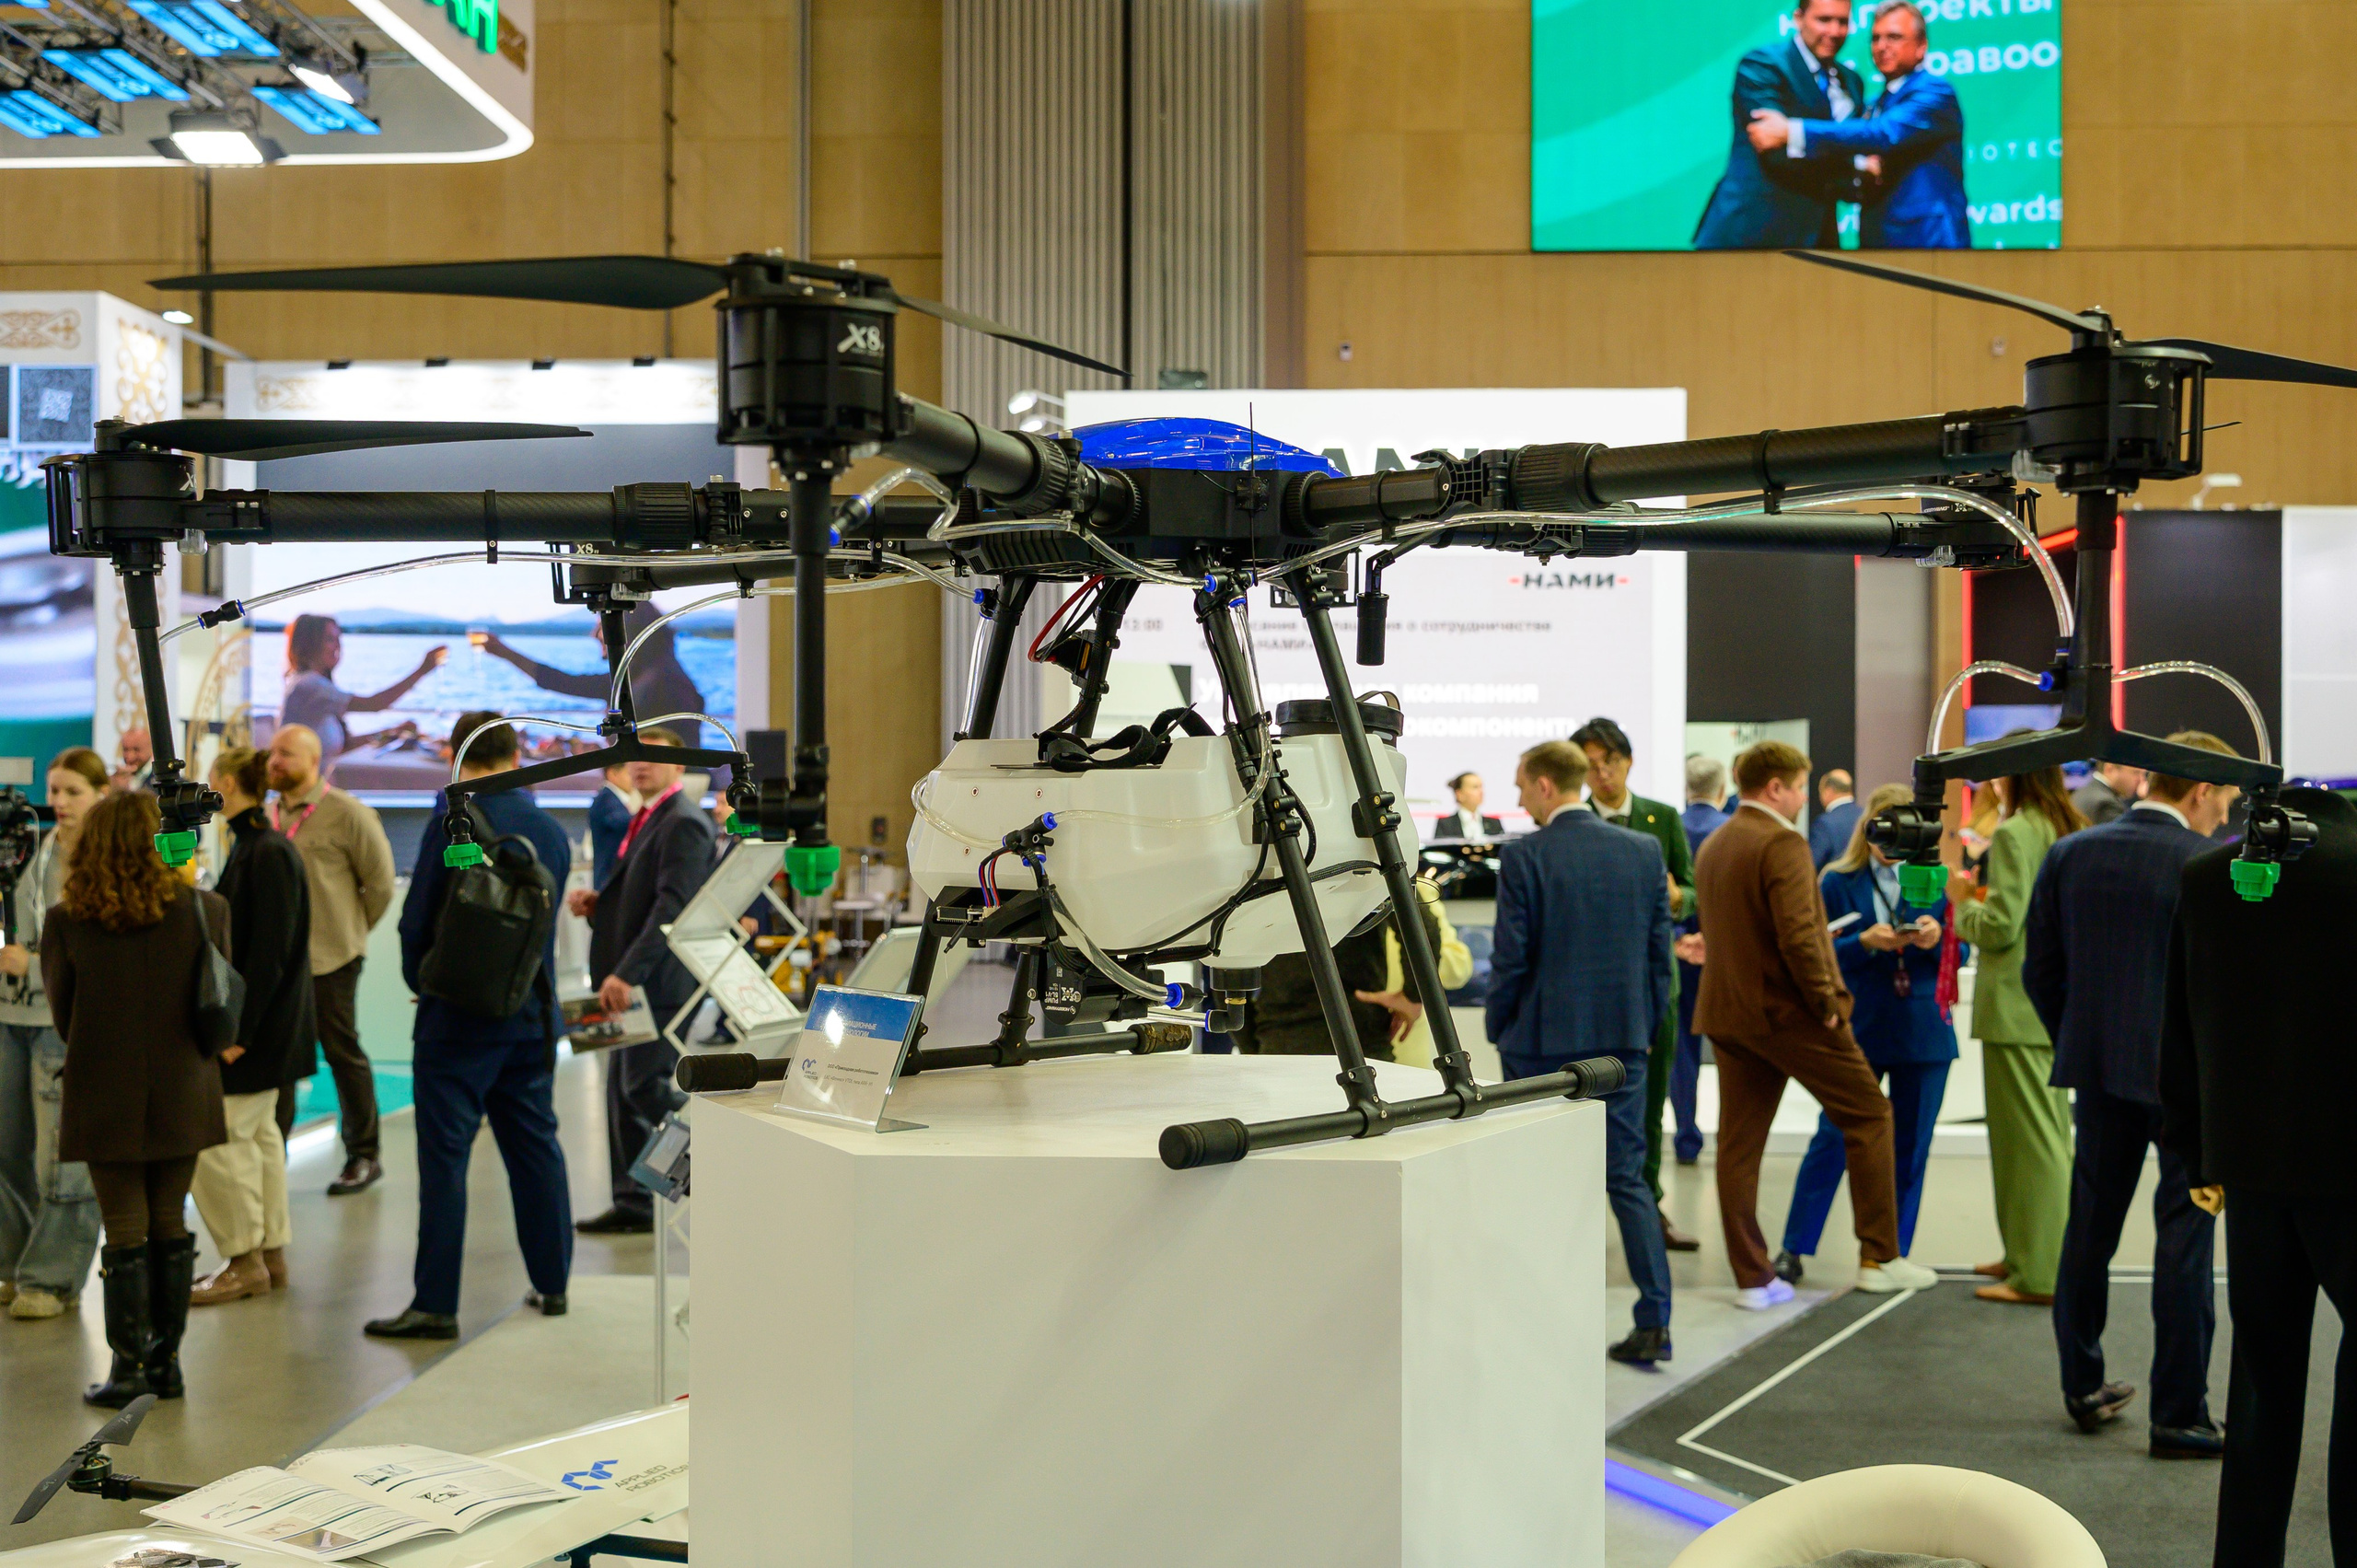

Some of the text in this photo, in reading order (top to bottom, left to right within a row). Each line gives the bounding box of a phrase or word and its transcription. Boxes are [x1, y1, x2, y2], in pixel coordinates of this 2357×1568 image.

[1968, 139, 2062, 161] IOTEC
[837, 322, 881, 354] X8
[179, 471, 197, 492] X
[1524, 572, 1615, 590] НАМИ
[614, 1464, 668, 1488] APPLIED
